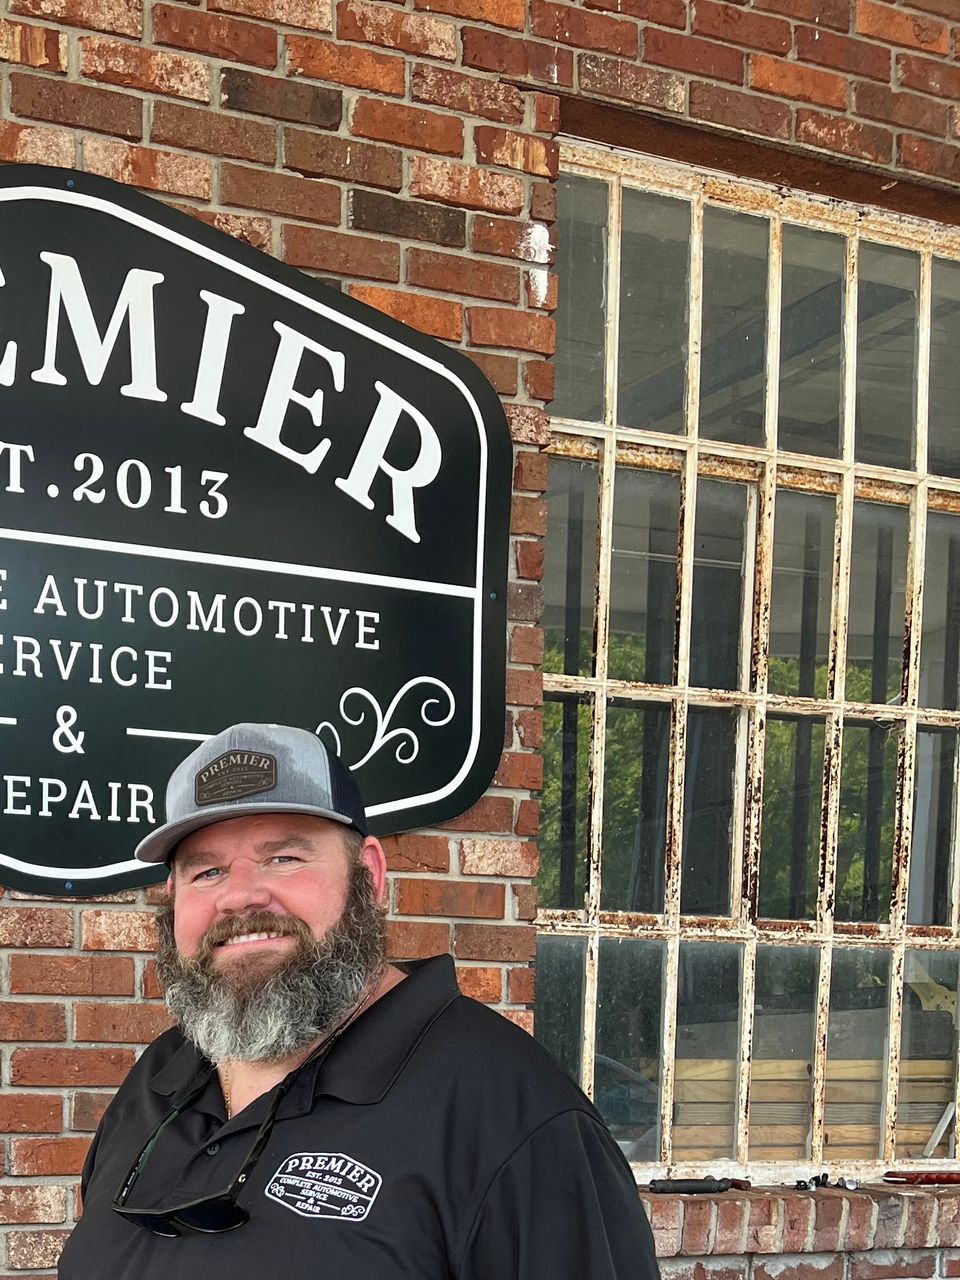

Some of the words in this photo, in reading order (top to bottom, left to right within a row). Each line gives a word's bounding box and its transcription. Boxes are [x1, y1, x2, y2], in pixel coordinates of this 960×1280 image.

[34, 575, 380, 650] AUTOMOTIVE
[53, 705, 86, 754] &
[201, 754, 271, 783] PREMIER
[285, 1156, 376, 1193] PREMIER
[279, 1177, 312, 1189] COMPLETE
[312, 1184, 360, 1203] AUTOMOTIVE
[299, 1188, 329, 1201] SERVICE
[295, 1201, 321, 1213] REPAIR
